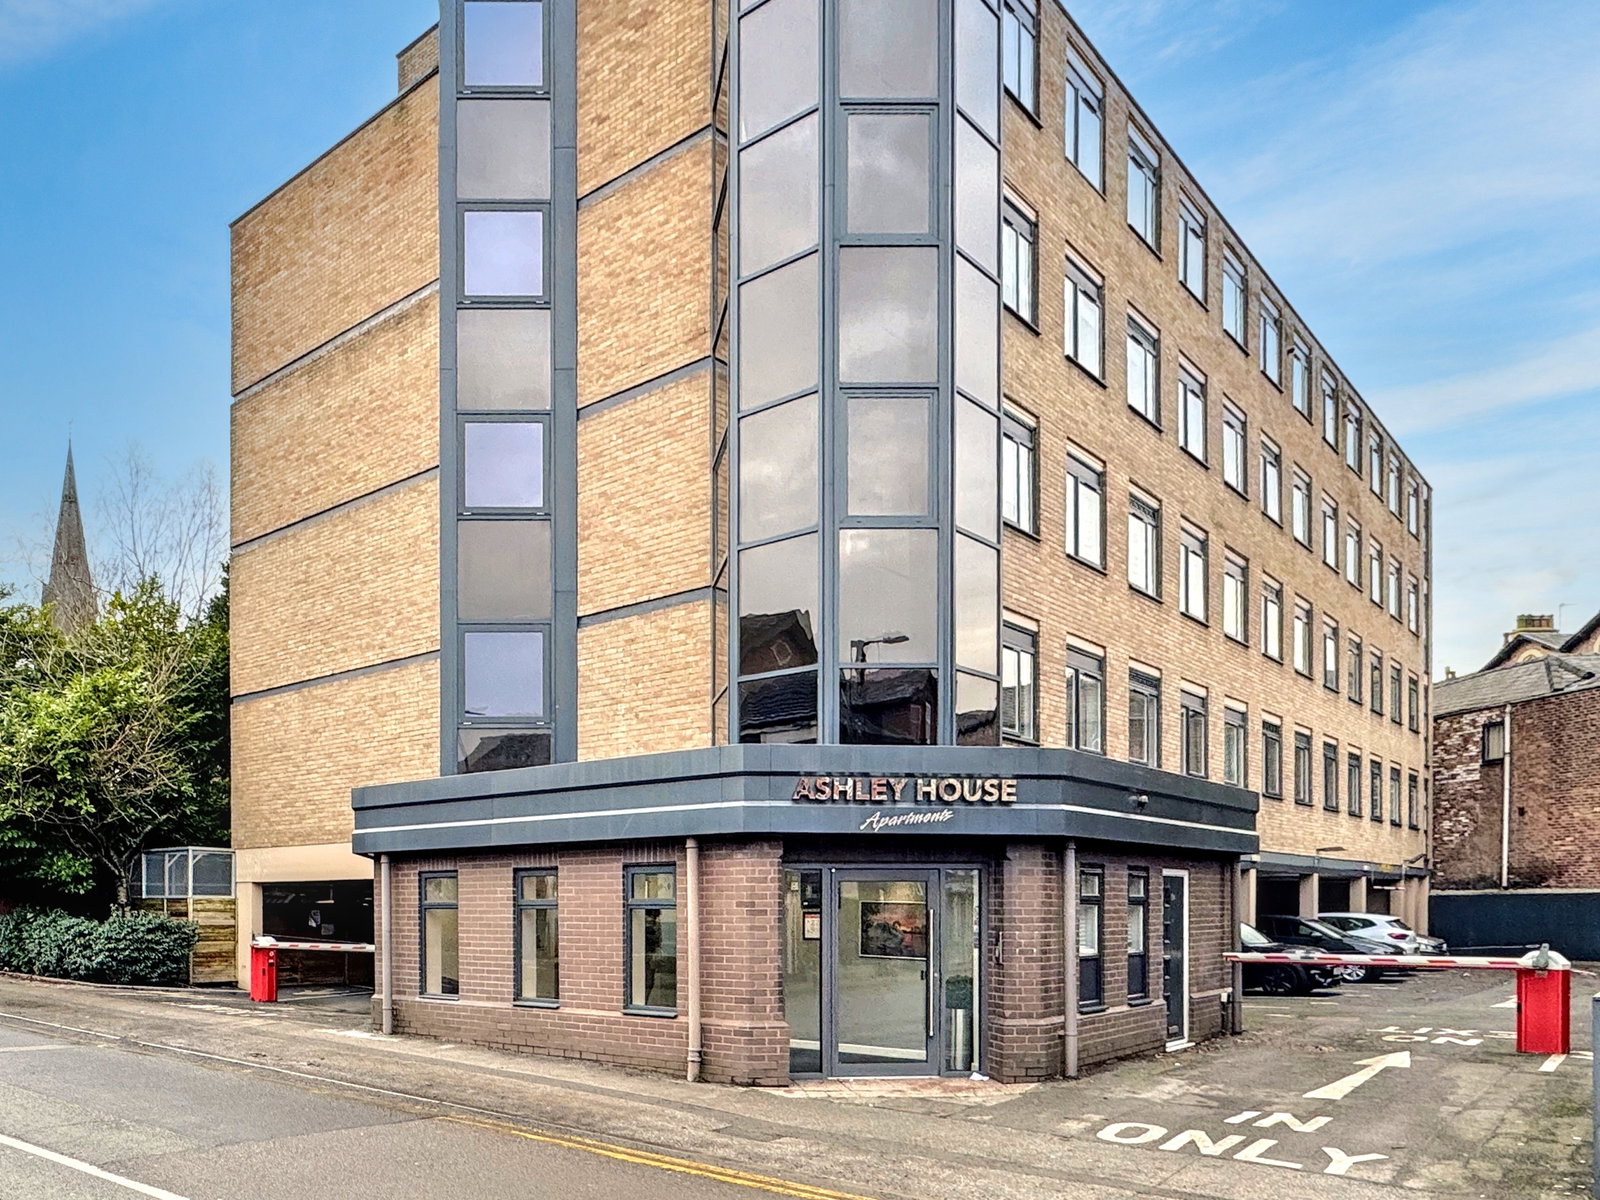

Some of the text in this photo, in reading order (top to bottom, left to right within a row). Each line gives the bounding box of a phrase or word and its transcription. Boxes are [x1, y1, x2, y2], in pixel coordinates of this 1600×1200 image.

[792, 777, 1018, 802] ASHLEY HOUSE
[860, 808, 954, 832] Apartments
[1223, 1111, 1334, 1133] IN
[1096, 1122, 1390, 1175] ONLY
